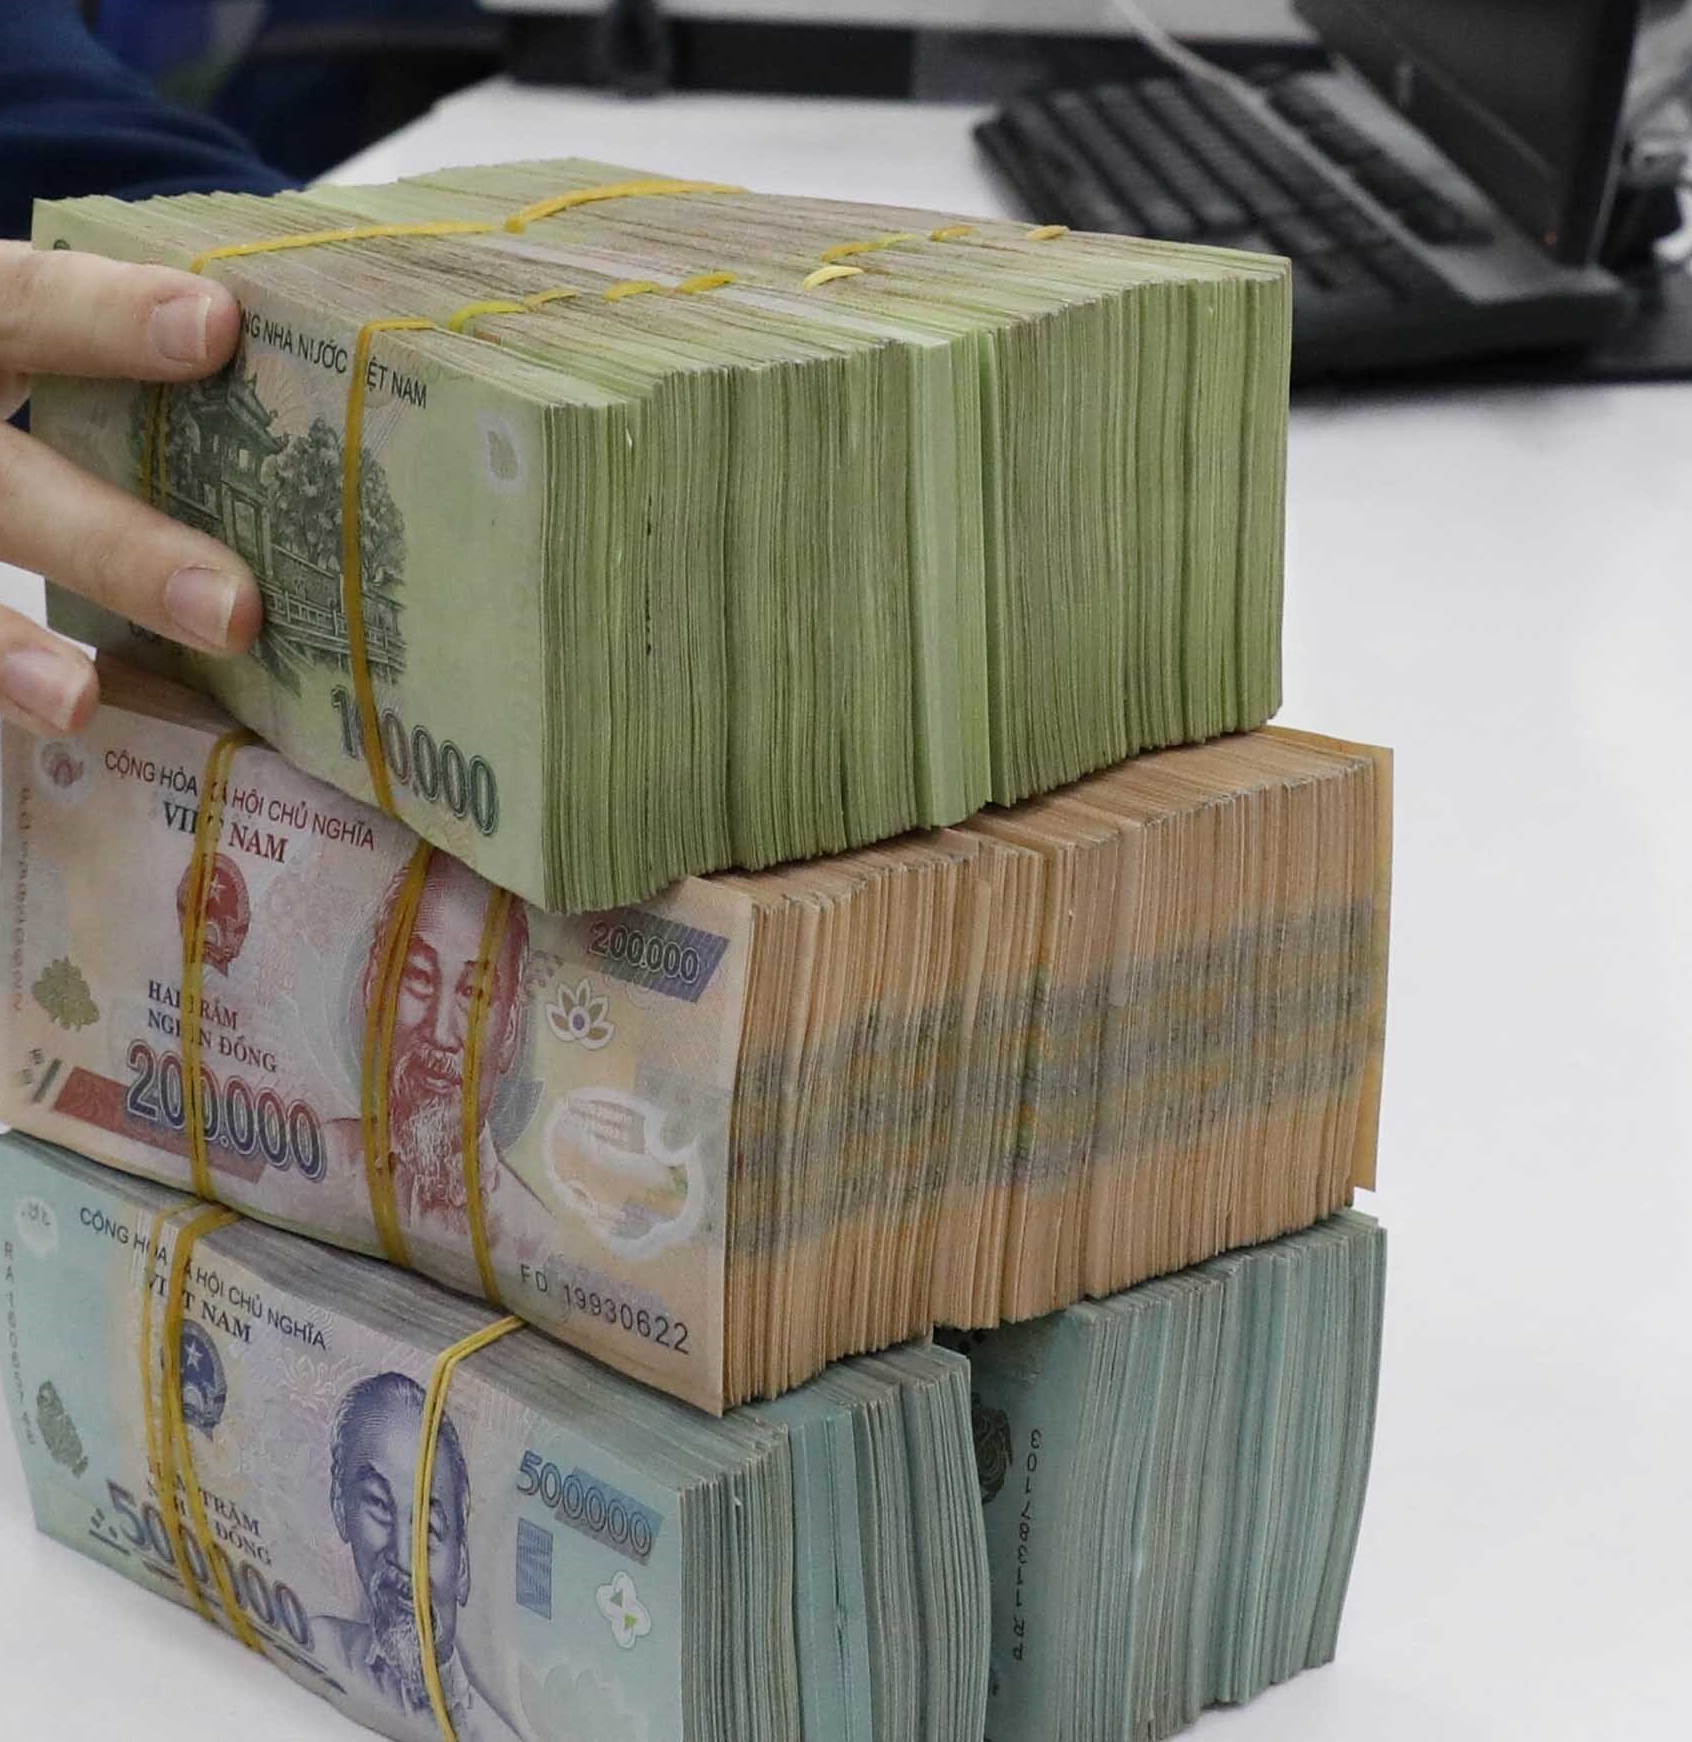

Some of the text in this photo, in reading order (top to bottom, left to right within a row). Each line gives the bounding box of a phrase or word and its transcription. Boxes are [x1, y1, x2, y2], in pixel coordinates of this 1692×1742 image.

[391, 370, 427, 410] NAM
[104, 749, 156, 783] CỘNG
[231, 786, 264, 820] HỘI
[267, 799, 309, 830] CHỦ
[311, 811, 375, 851] NGHĨA
[228, 821, 288, 864] NAM
[79, 1207, 129, 1244] CỘNG
[195, 1266, 224, 1298] HỘI
[228, 1285, 263, 1319] CHỦ
[267, 1307, 326, 1350] NGHĨA
[520, 1263, 689, 1356] FD 19930622
[201, 1299, 252, 1344] NAM
